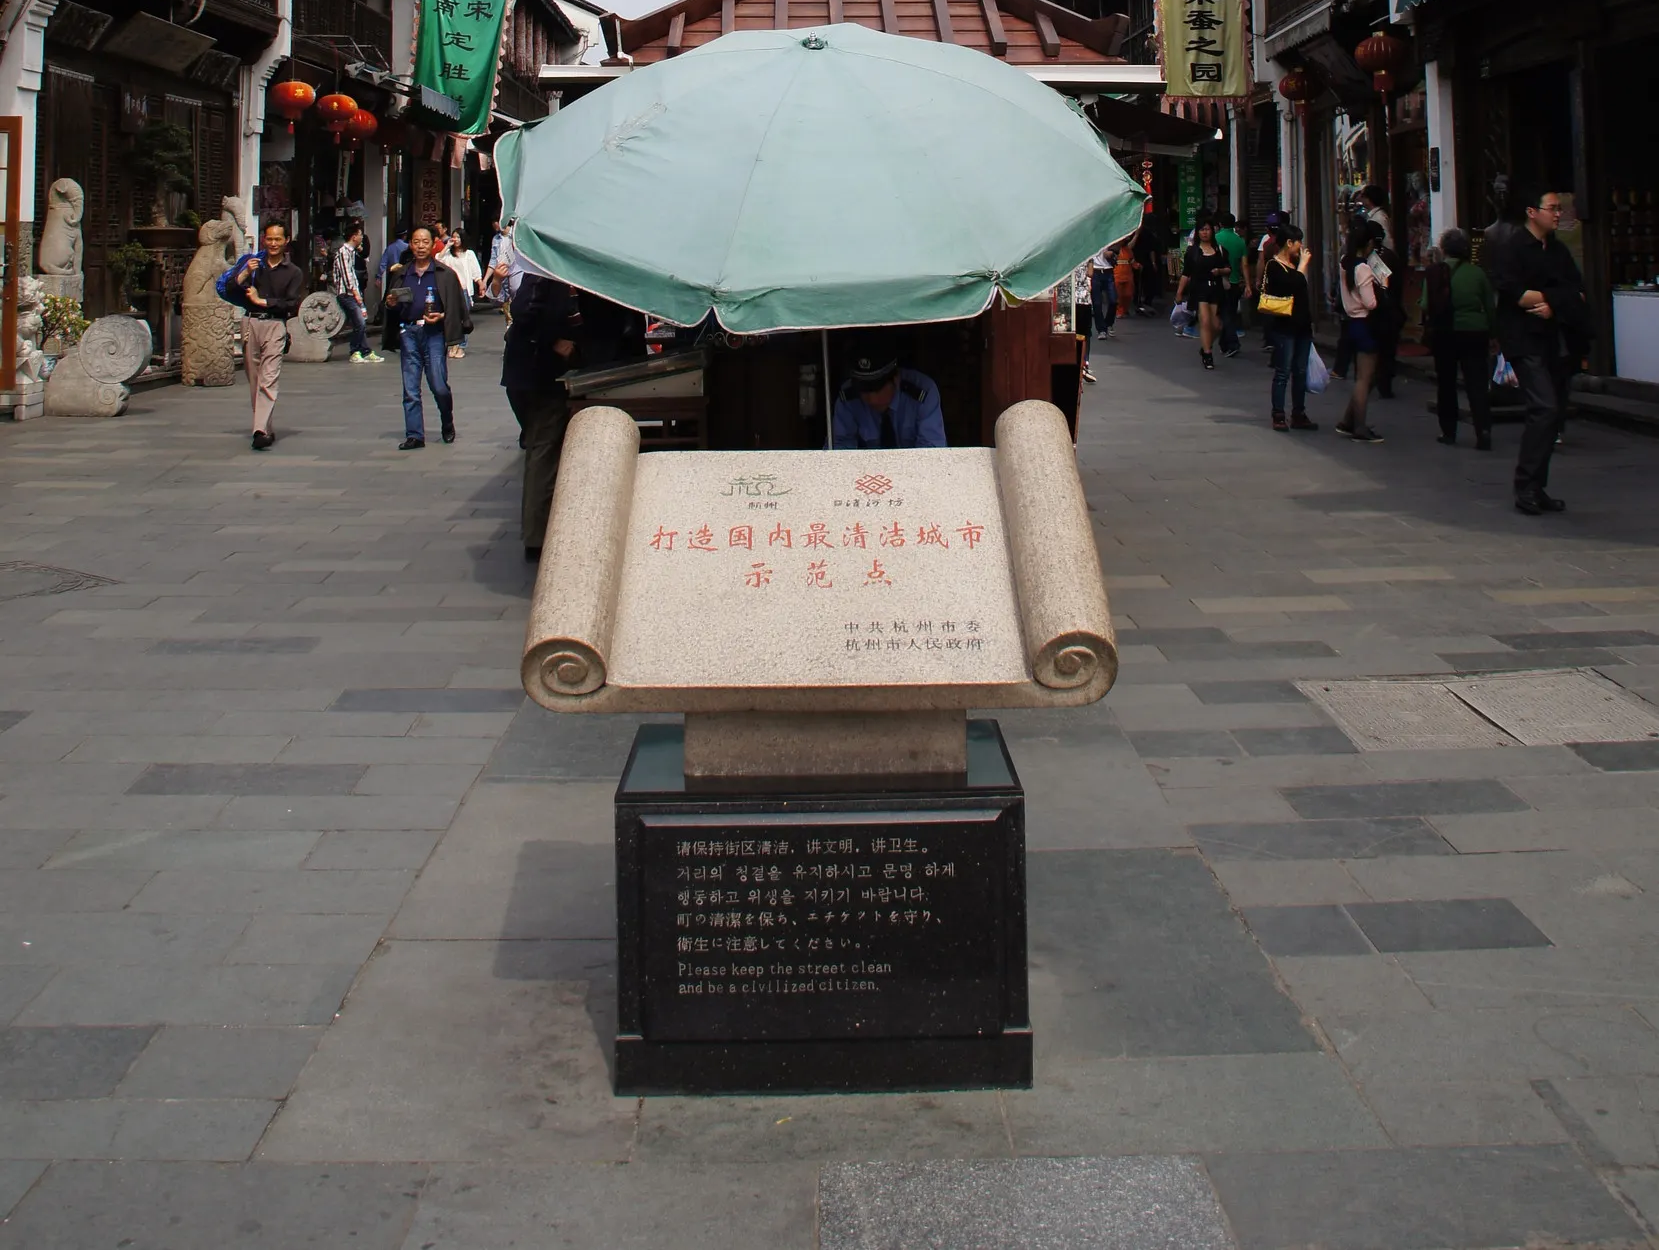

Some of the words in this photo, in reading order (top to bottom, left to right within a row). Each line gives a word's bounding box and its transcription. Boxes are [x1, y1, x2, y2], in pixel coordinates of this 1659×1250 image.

[438, 32, 475, 115] 定胜
[649, 519, 985, 551] 打造国内最清洁城市
[744, 558, 893, 589] 示范点
[844, 620, 981, 634] 中共杭州市委
[845, 637, 983, 651] 杭州市人民政府
[677, 865, 722, 881] 거리의
[736, 865, 781, 882] 청결을
[793, 863, 872, 880] 유지하시고
[883, 863, 912, 879] 문명
[925, 862, 955, 878] 하게
[678, 890, 740, 906] 행동하고
[748, 889, 794, 905] 위생을
[804, 888, 850, 903] 지키기
[678, 962, 727, 977] Please
[732, 961, 764, 978] keep
[770, 961, 793, 975] the
[798, 961, 846, 975] street
[851, 960, 892, 974] clean
[678, 981, 703, 994] and
[708, 981, 724, 993] be
[729, 984, 737, 993] a
[742, 979, 814, 993] civilized
[819, 978, 880, 991] citizen.
